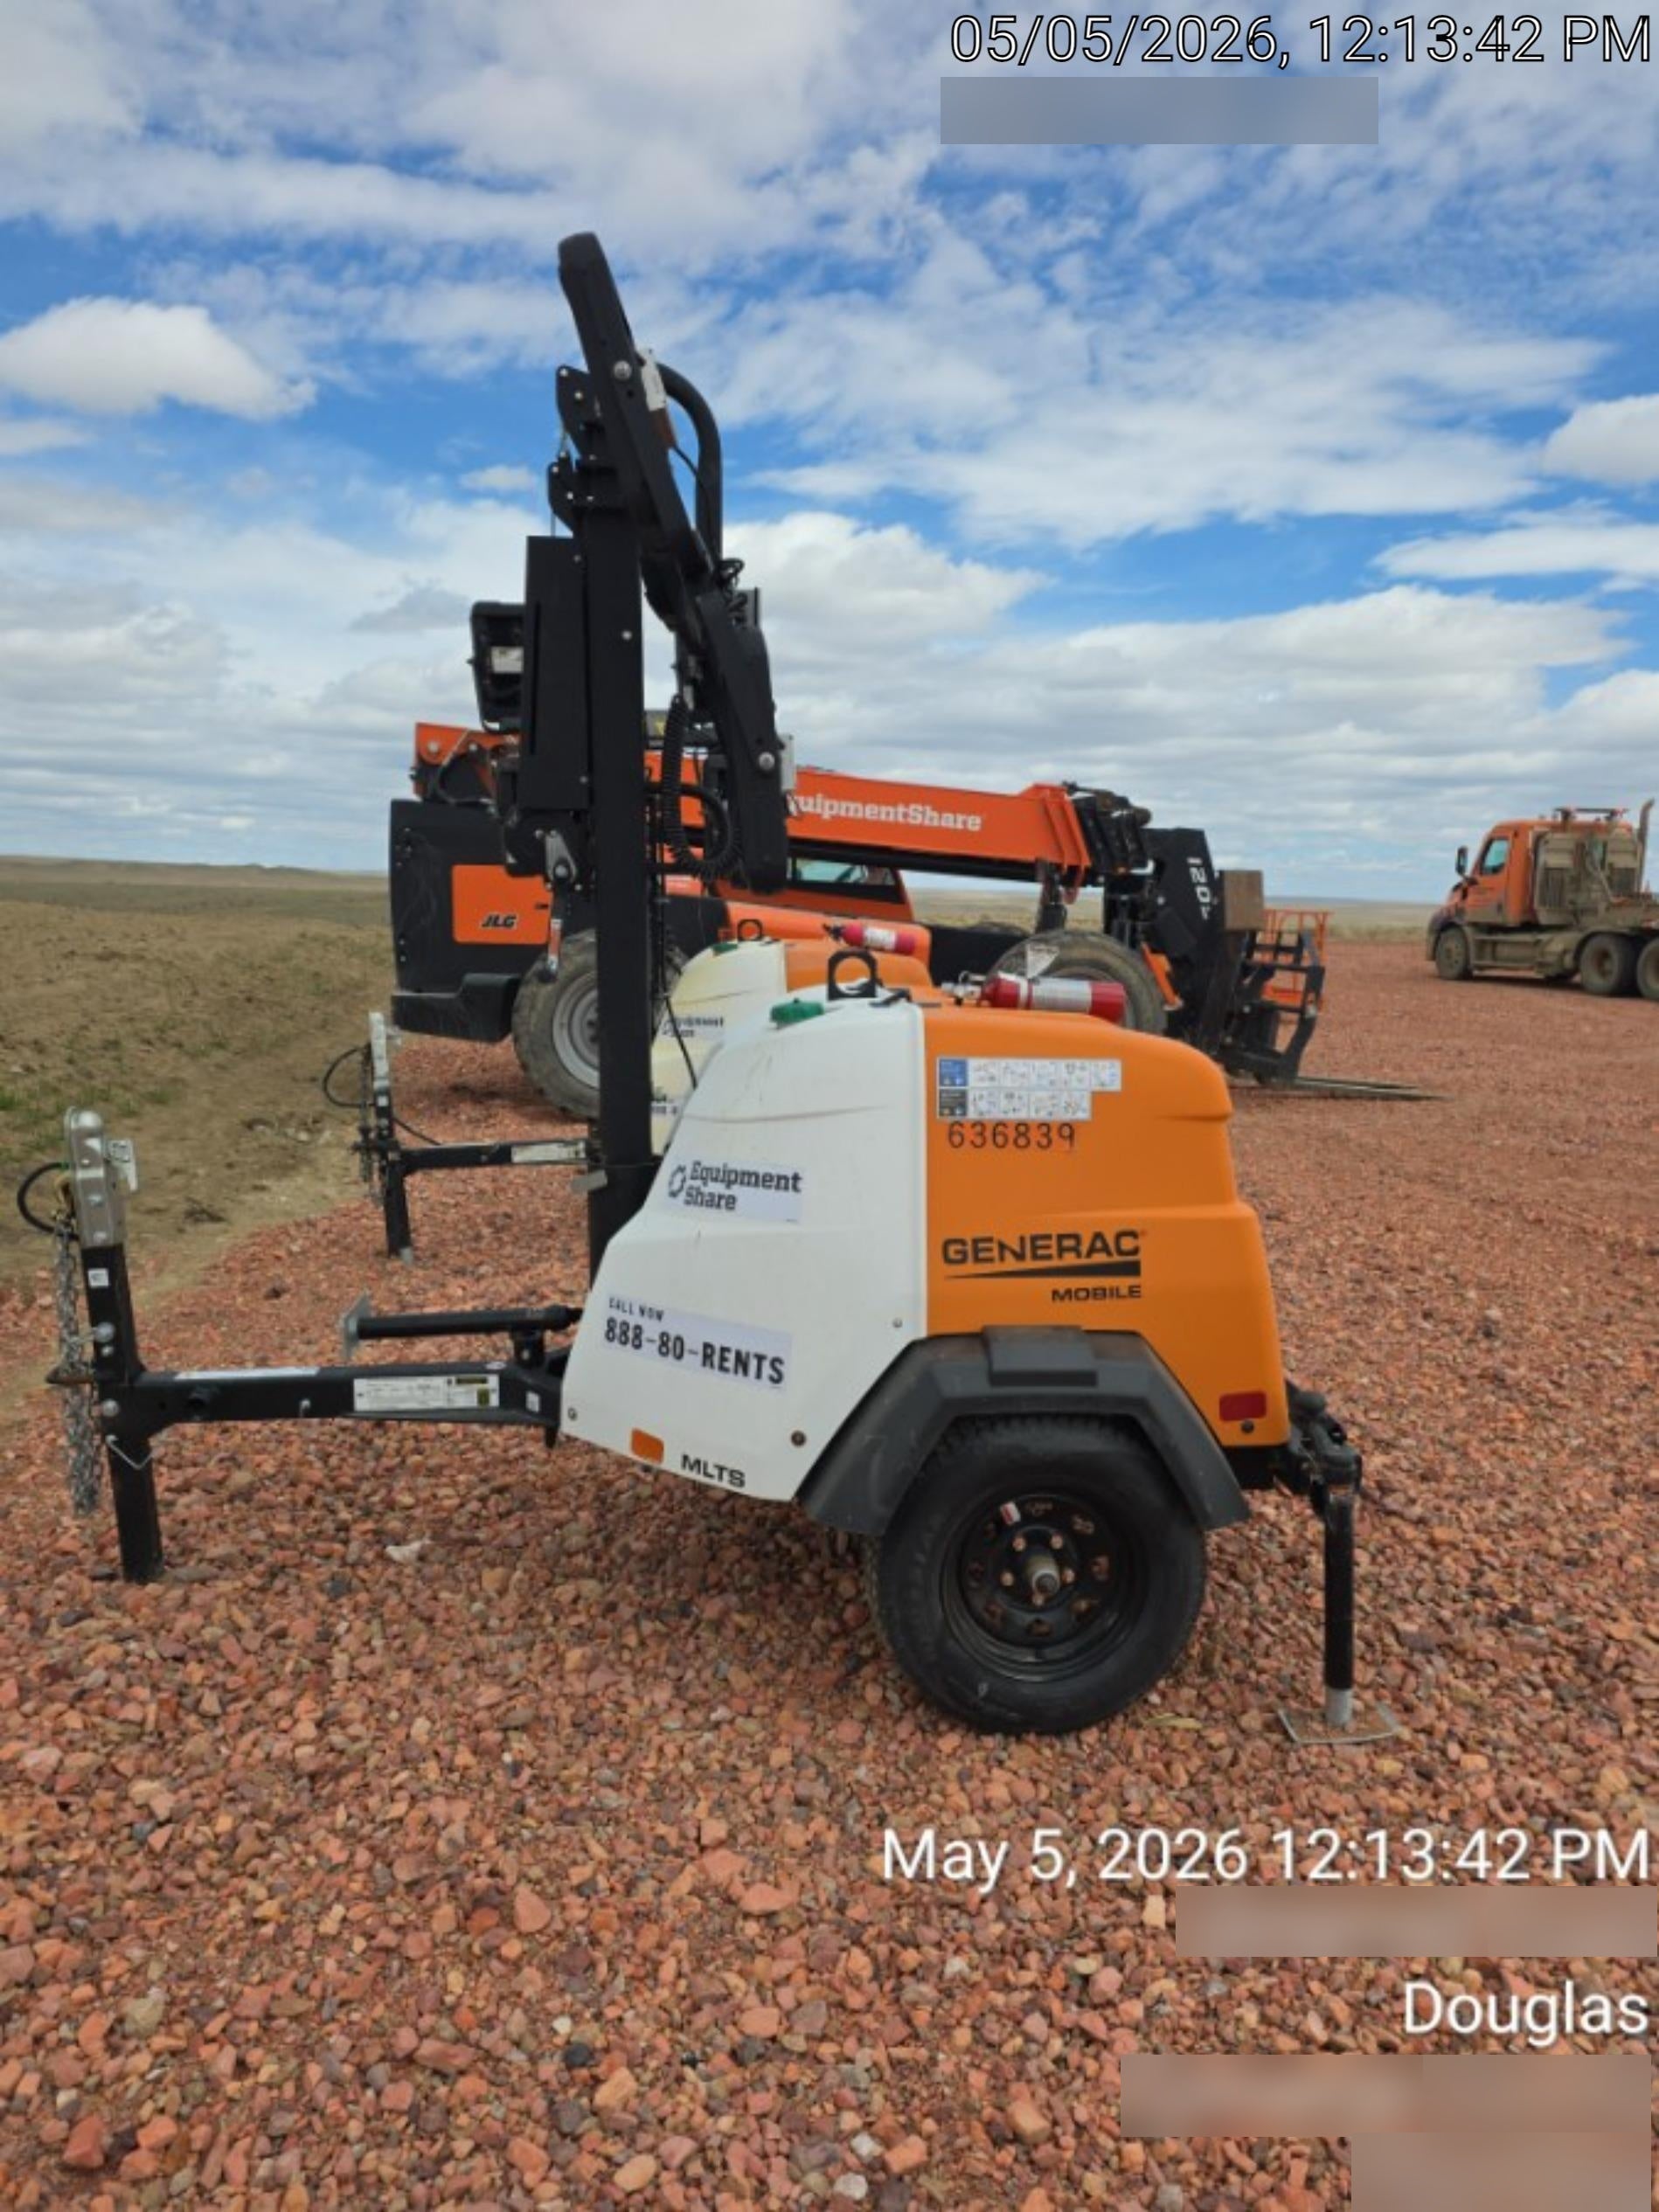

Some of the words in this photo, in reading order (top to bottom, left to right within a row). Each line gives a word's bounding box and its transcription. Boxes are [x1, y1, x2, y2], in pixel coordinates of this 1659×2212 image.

[480, 912, 519, 930] JLG
[948, 1120, 1075, 1149] 636839
[690, 1160, 802, 1193] Equipment
[684, 1185, 737, 1210] Share
[941, 1230, 1140, 1265] GENERAC
[1052, 1285, 1141, 1302] MOBILE
[604, 1316, 785, 1385] 888-80-RENTS
[682, 1453, 746, 1487] MLTS
